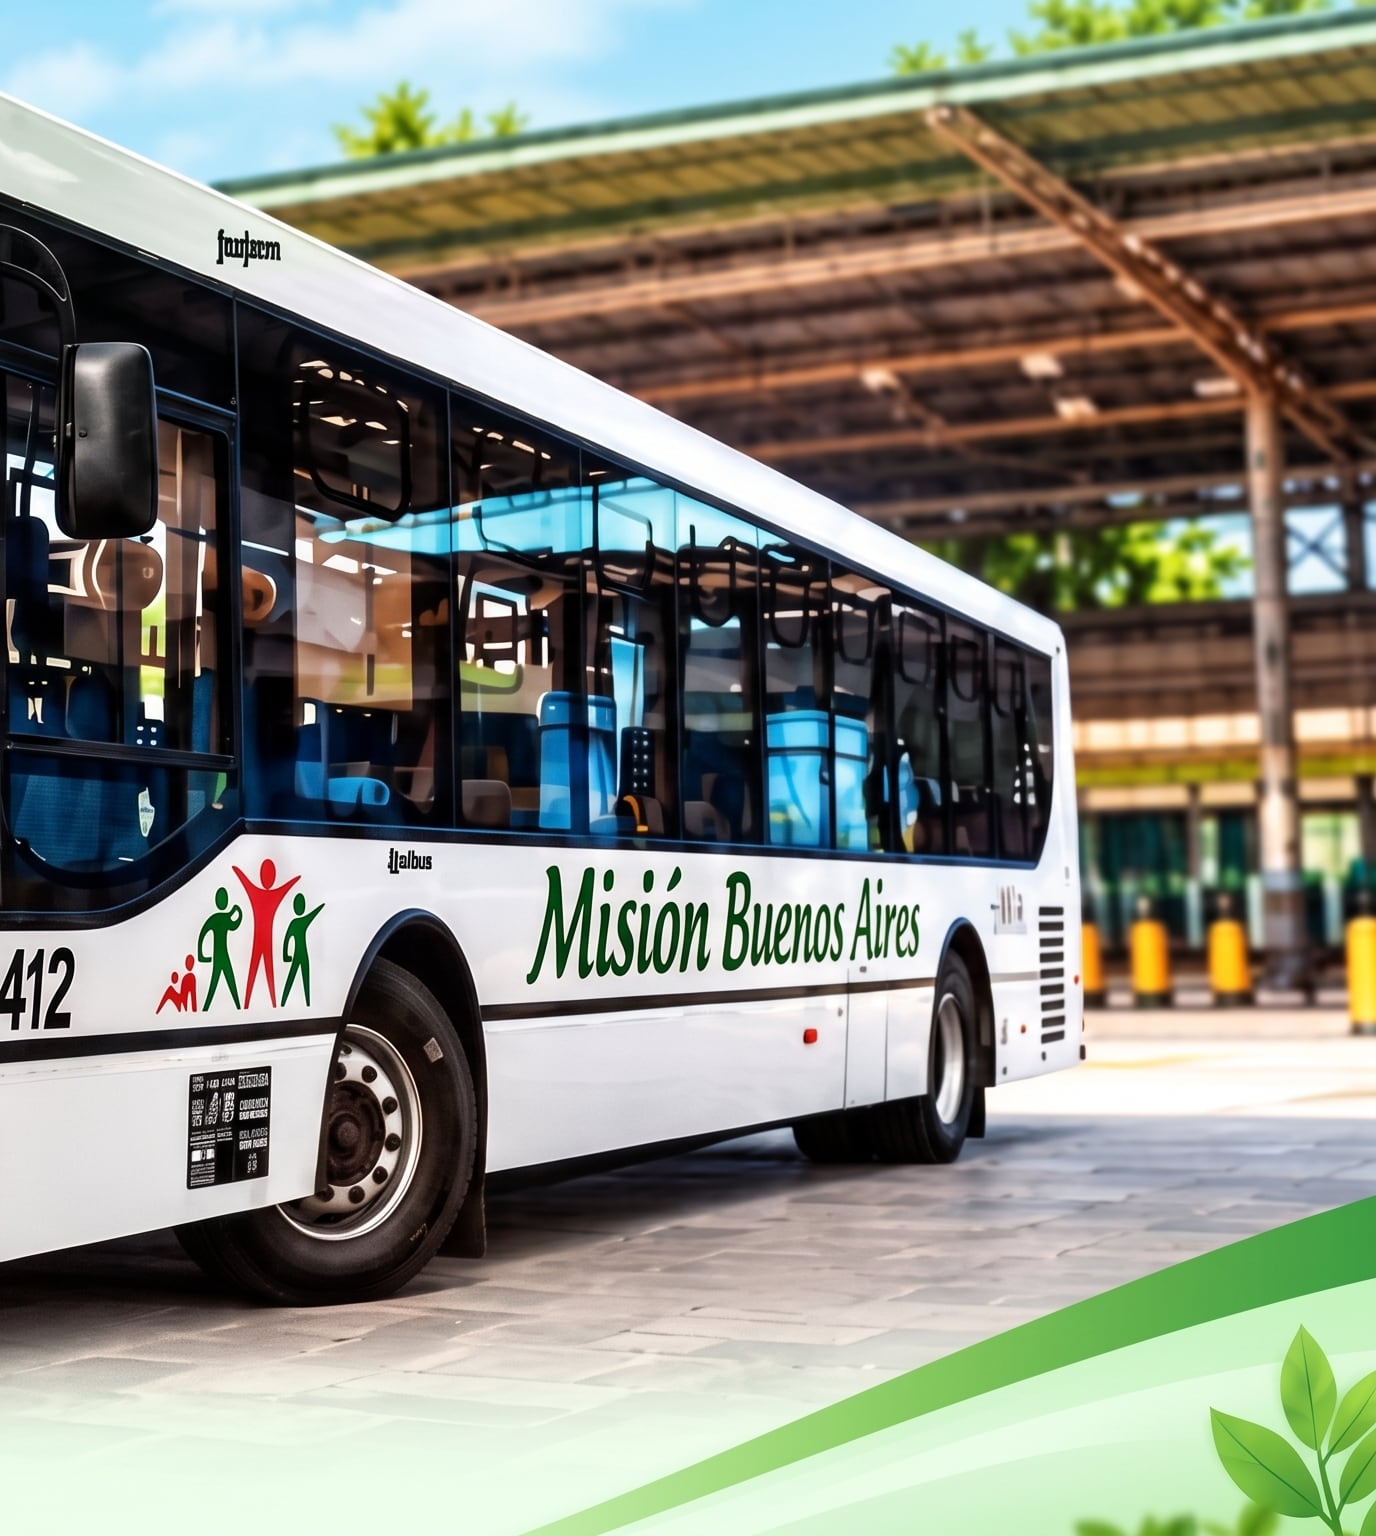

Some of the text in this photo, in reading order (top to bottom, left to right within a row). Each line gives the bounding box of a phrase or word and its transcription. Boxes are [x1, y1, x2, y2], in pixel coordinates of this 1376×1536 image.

[527, 865, 921, 984] Misión Buenos Aires
